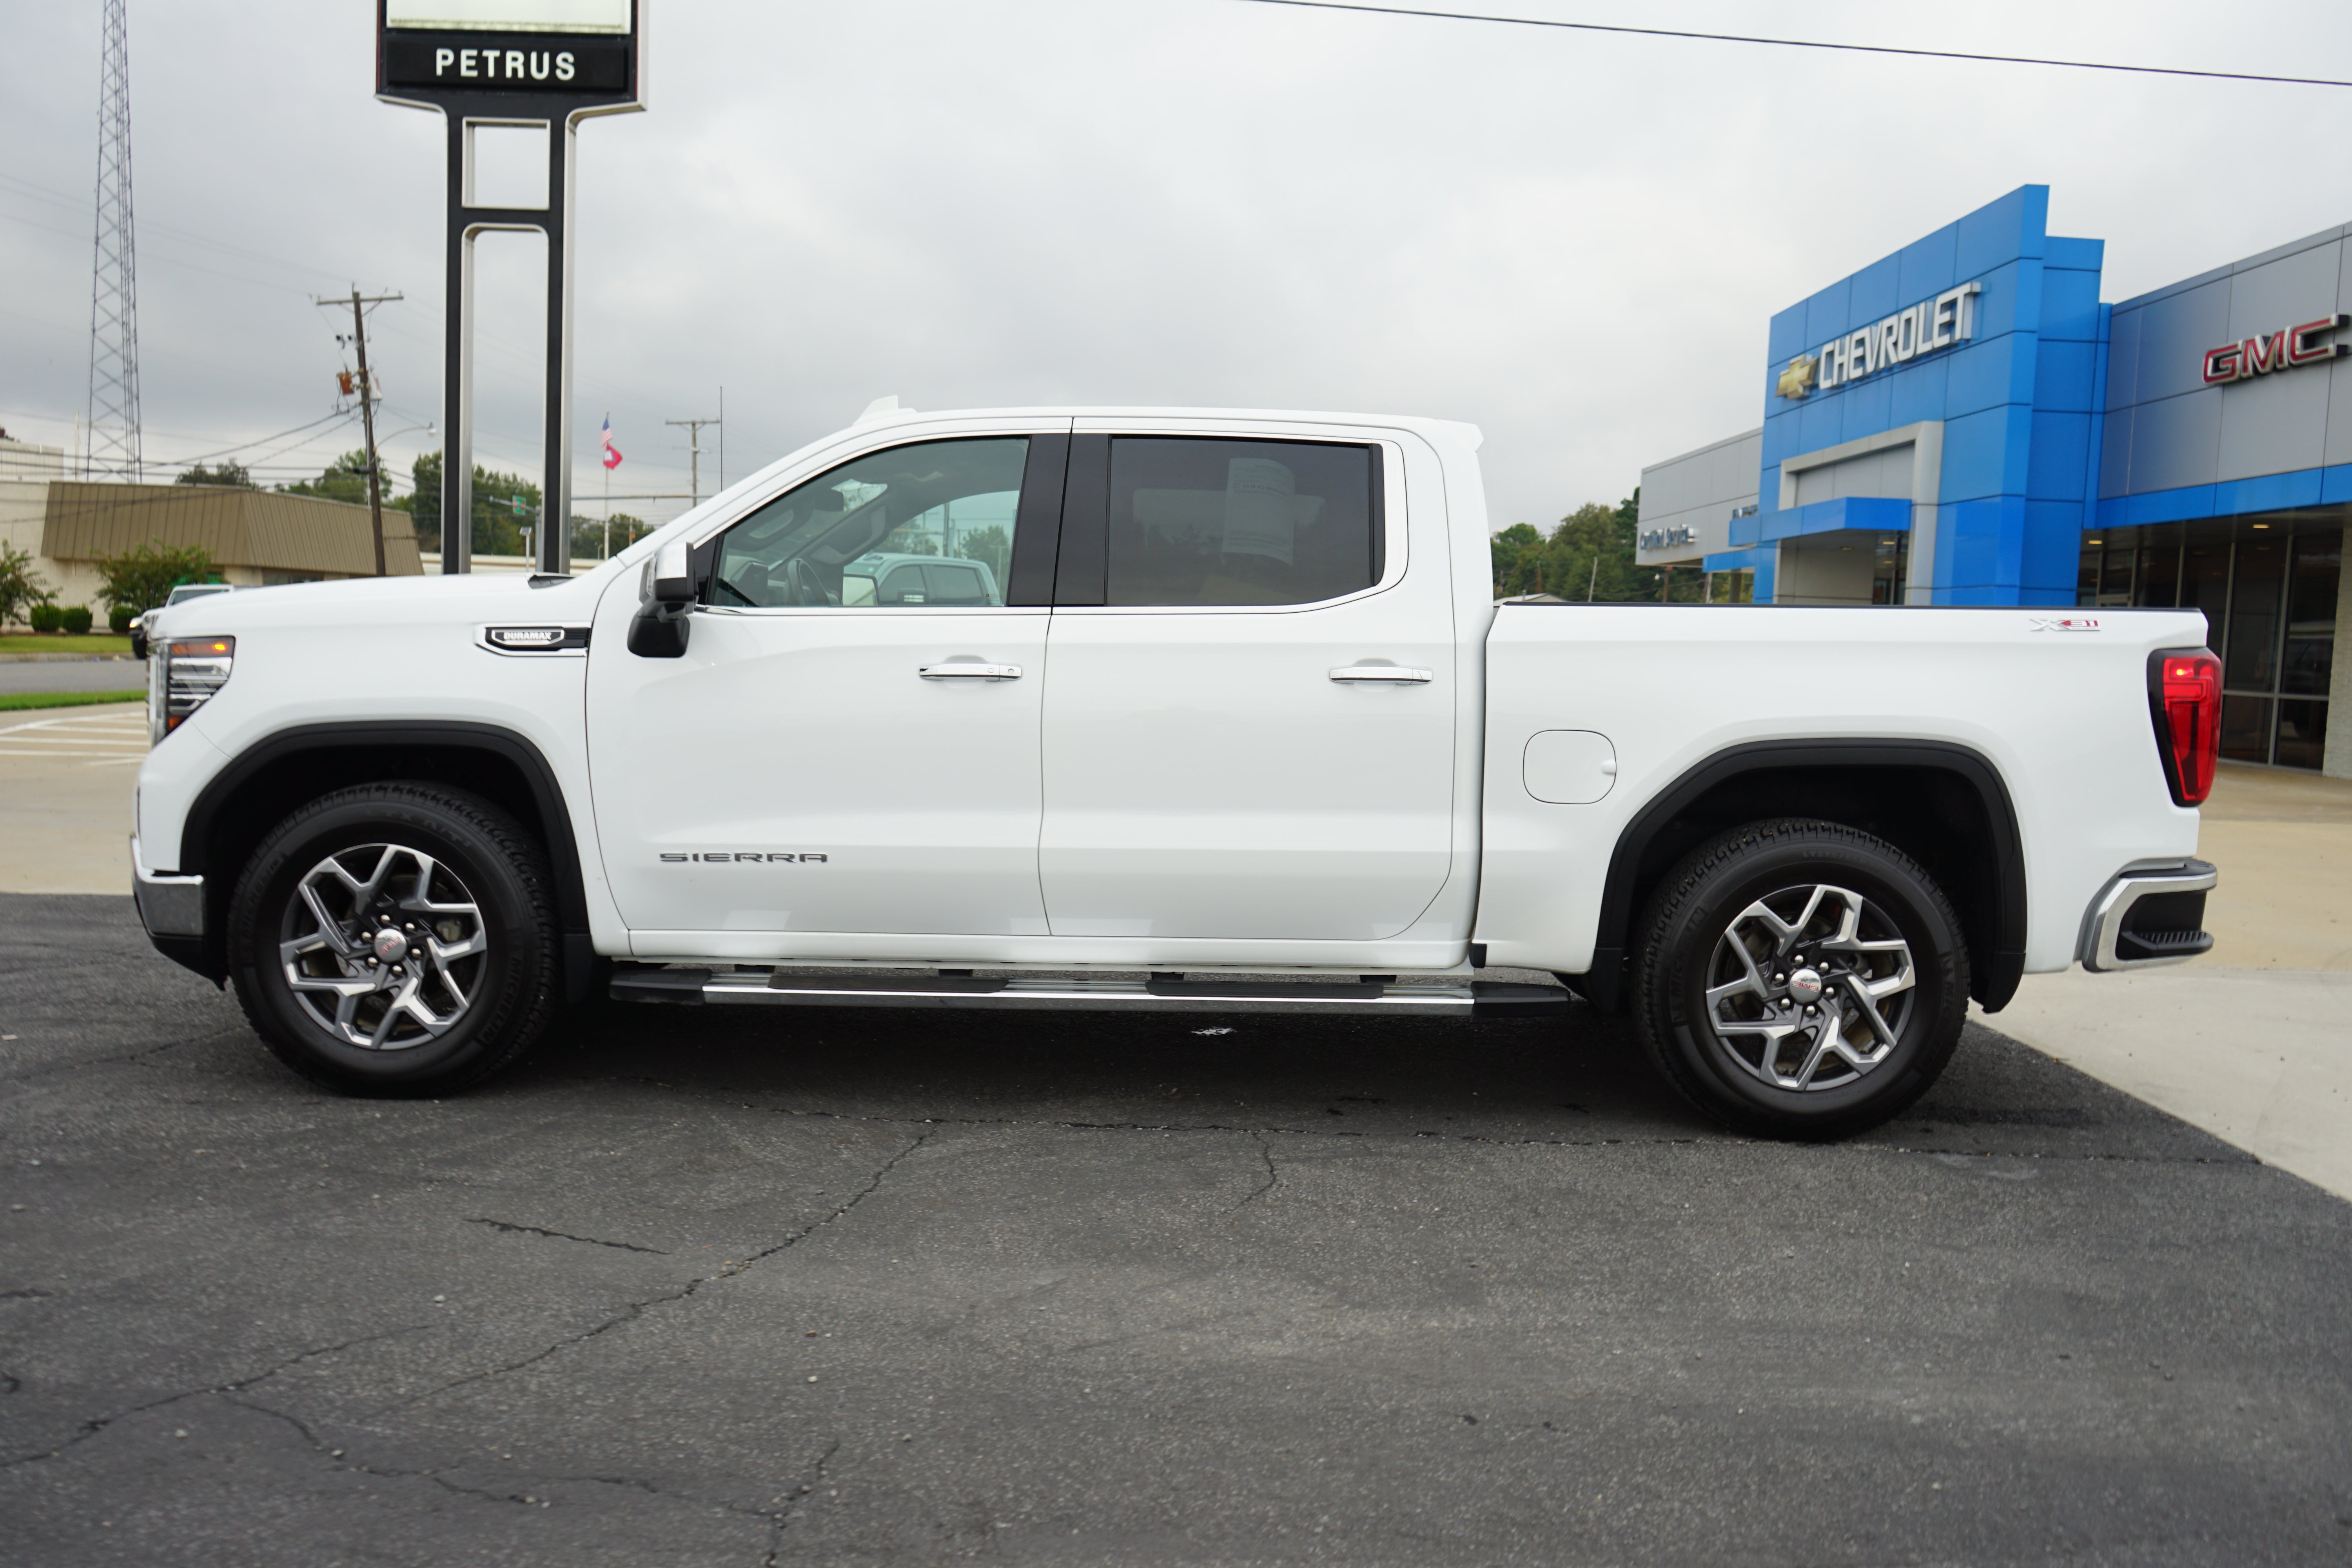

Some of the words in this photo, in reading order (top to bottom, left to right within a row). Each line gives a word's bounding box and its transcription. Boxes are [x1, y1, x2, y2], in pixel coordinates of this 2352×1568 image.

[436, 48, 575, 80] PETRUS
[1819, 281, 1981, 389] CHEVROLET
[2202, 314, 2340, 386] GMC
[503, 632, 552, 640] DURAMAX
[660, 852, 828, 862] SIERRA
[480, 956, 523, 1043] MICHELIN
[1792, 980, 1820, 993] GMC
